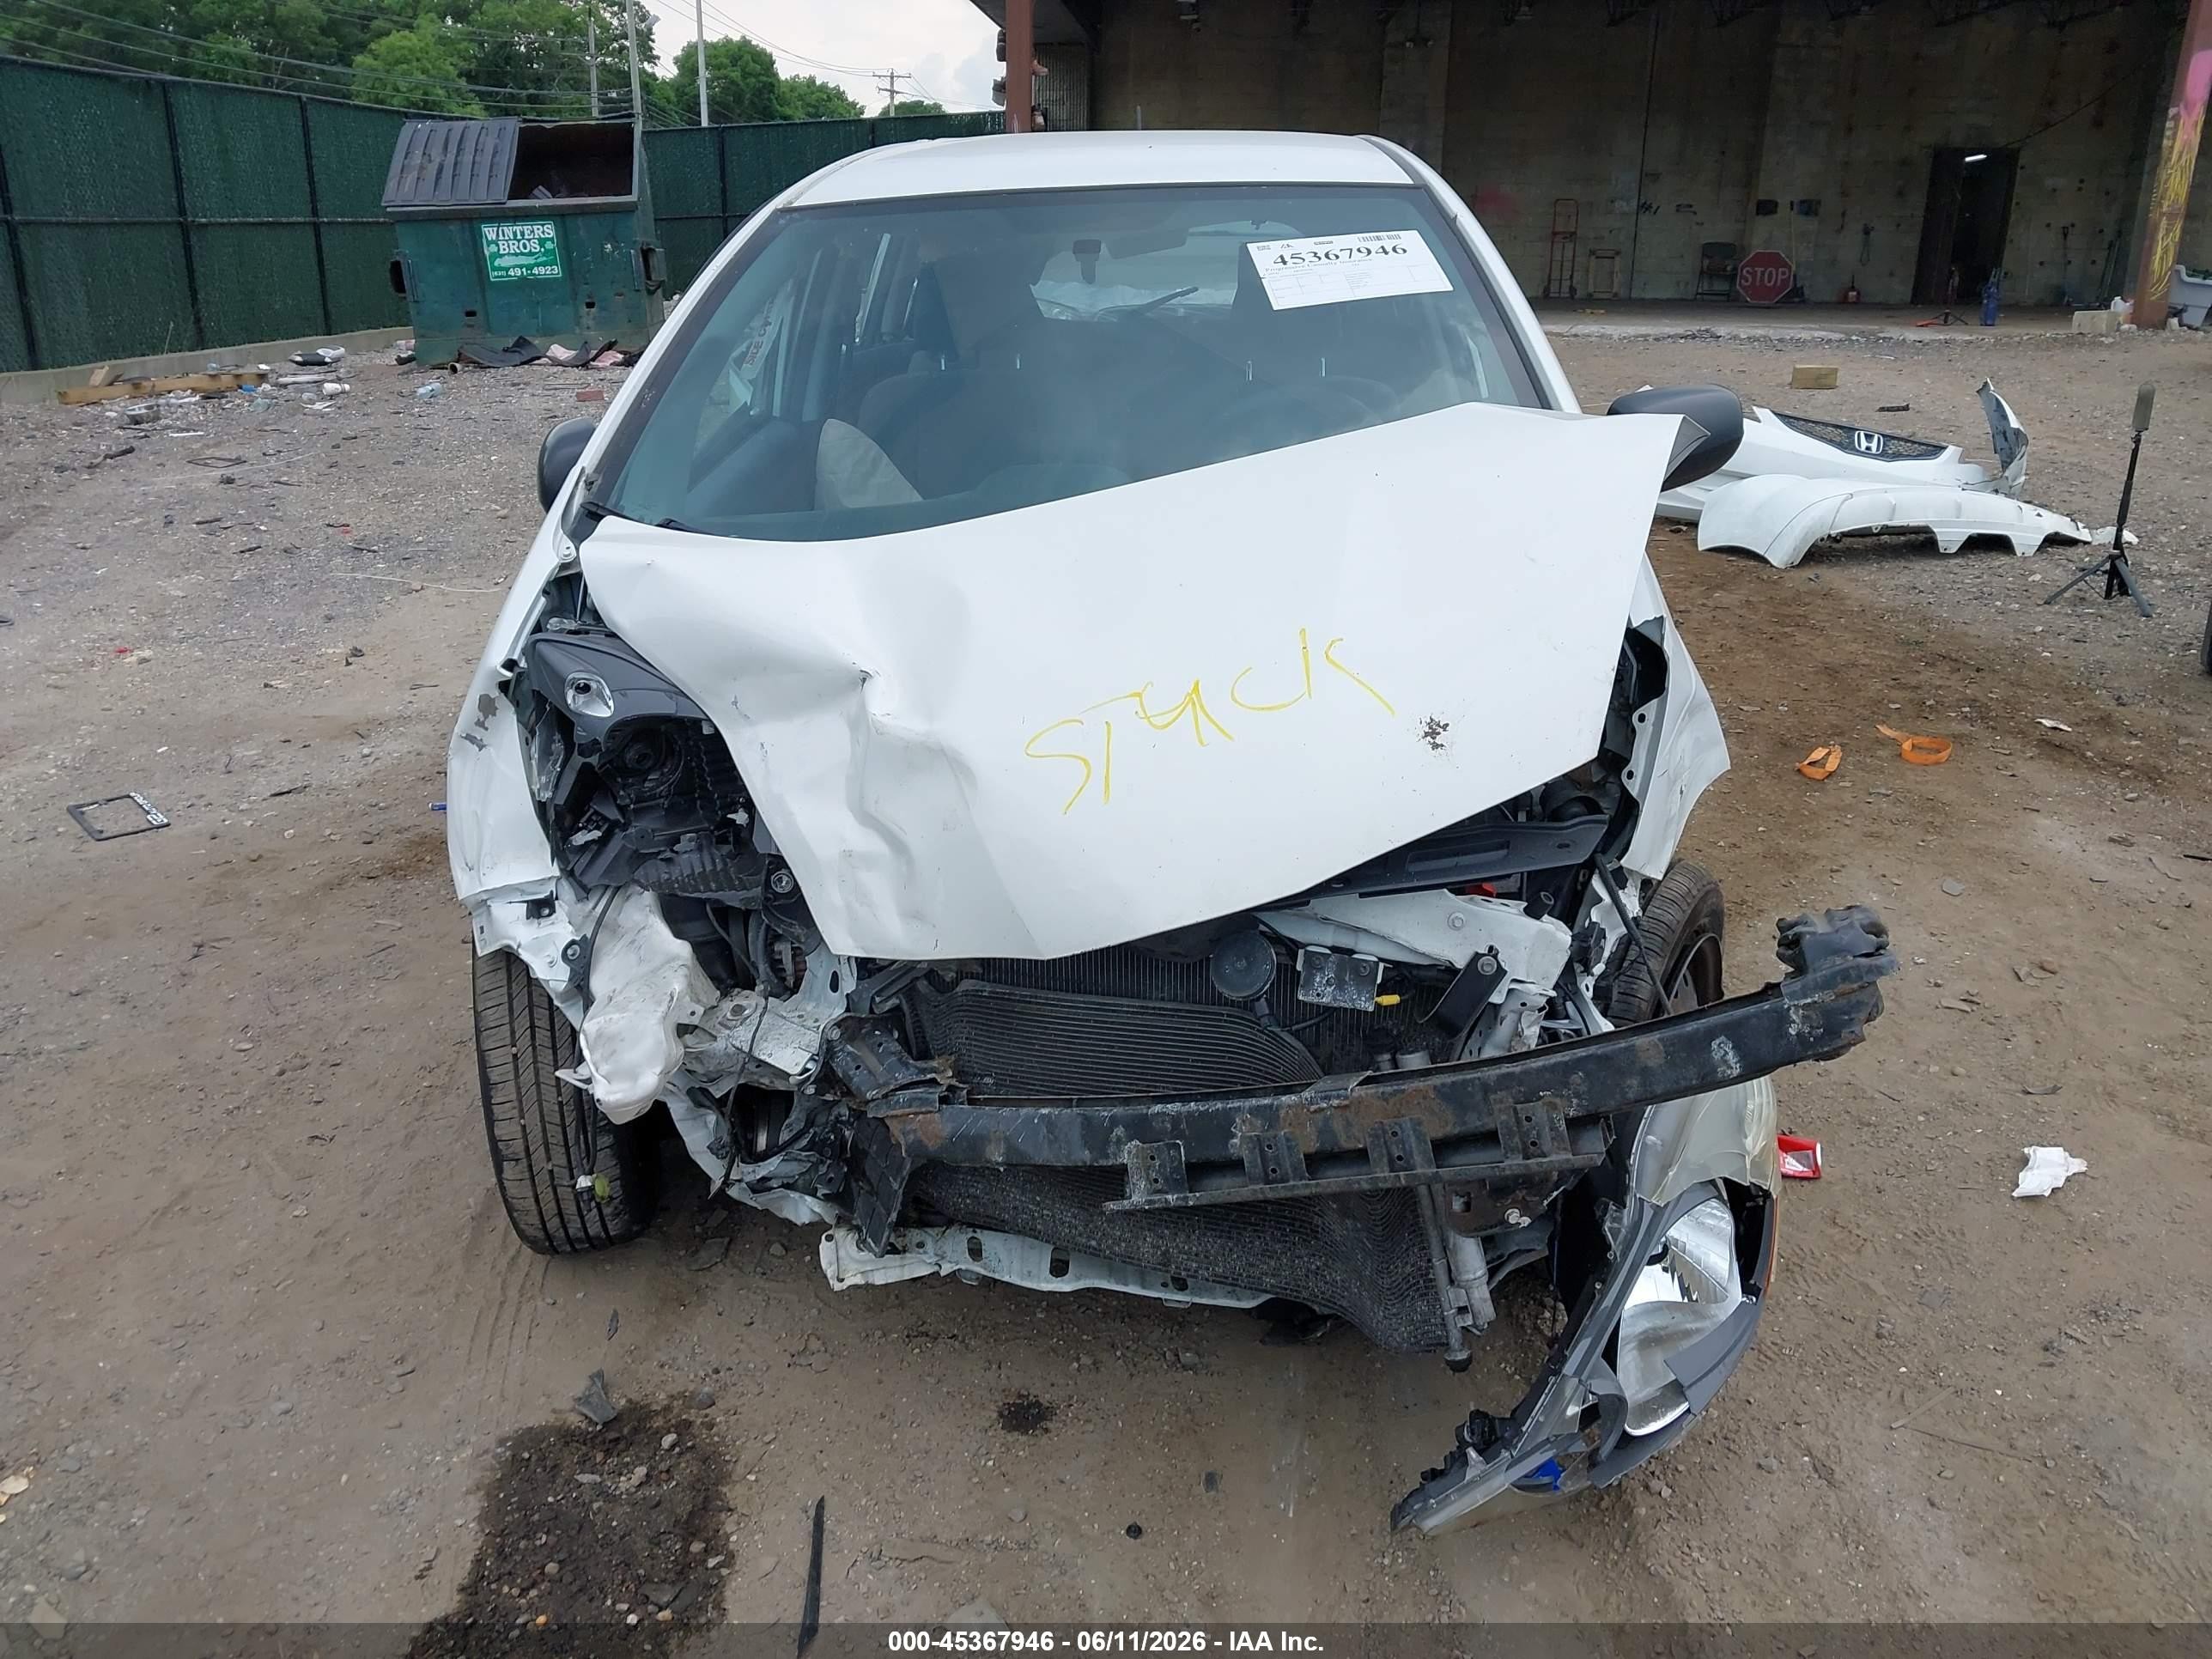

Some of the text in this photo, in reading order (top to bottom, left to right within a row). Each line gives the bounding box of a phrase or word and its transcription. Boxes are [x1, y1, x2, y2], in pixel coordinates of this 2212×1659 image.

[483, 224, 554, 240] WINTERS
[497, 239, 544, 254] BROS.
[1273, 243, 1407, 265] 45367946
[507, 266, 558, 276] 491-4923
[1741, 267, 1789, 287] STOP
